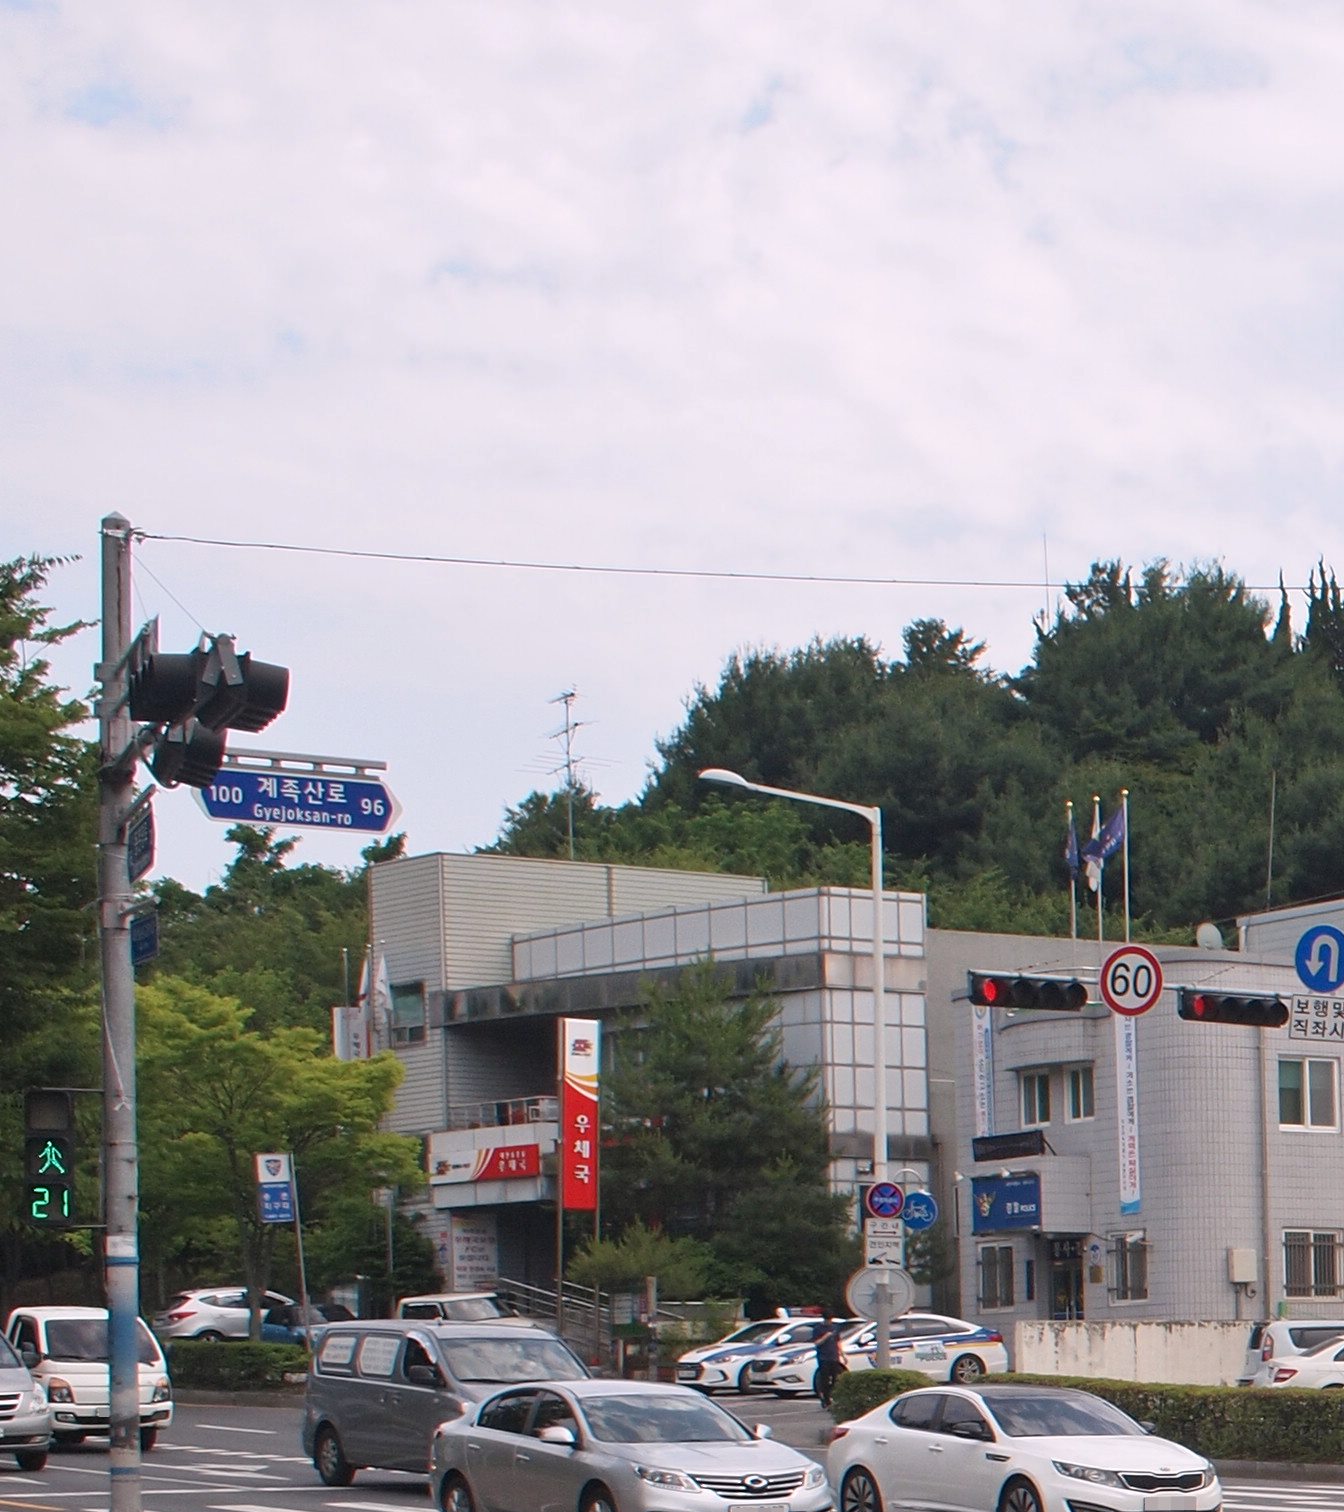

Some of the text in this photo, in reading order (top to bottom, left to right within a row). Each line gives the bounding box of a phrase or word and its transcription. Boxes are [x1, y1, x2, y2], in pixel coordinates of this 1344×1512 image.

[209, 785, 244, 805] 100
[257, 776, 348, 806] 계족산로
[253, 803, 353, 826] Gyejoksan-ro
[361, 798, 385, 817] 96
[1111, 963, 1152, 999] 60
[573, 1114, 591, 1184] 우체국
[32, 1187, 69, 1218] 21
